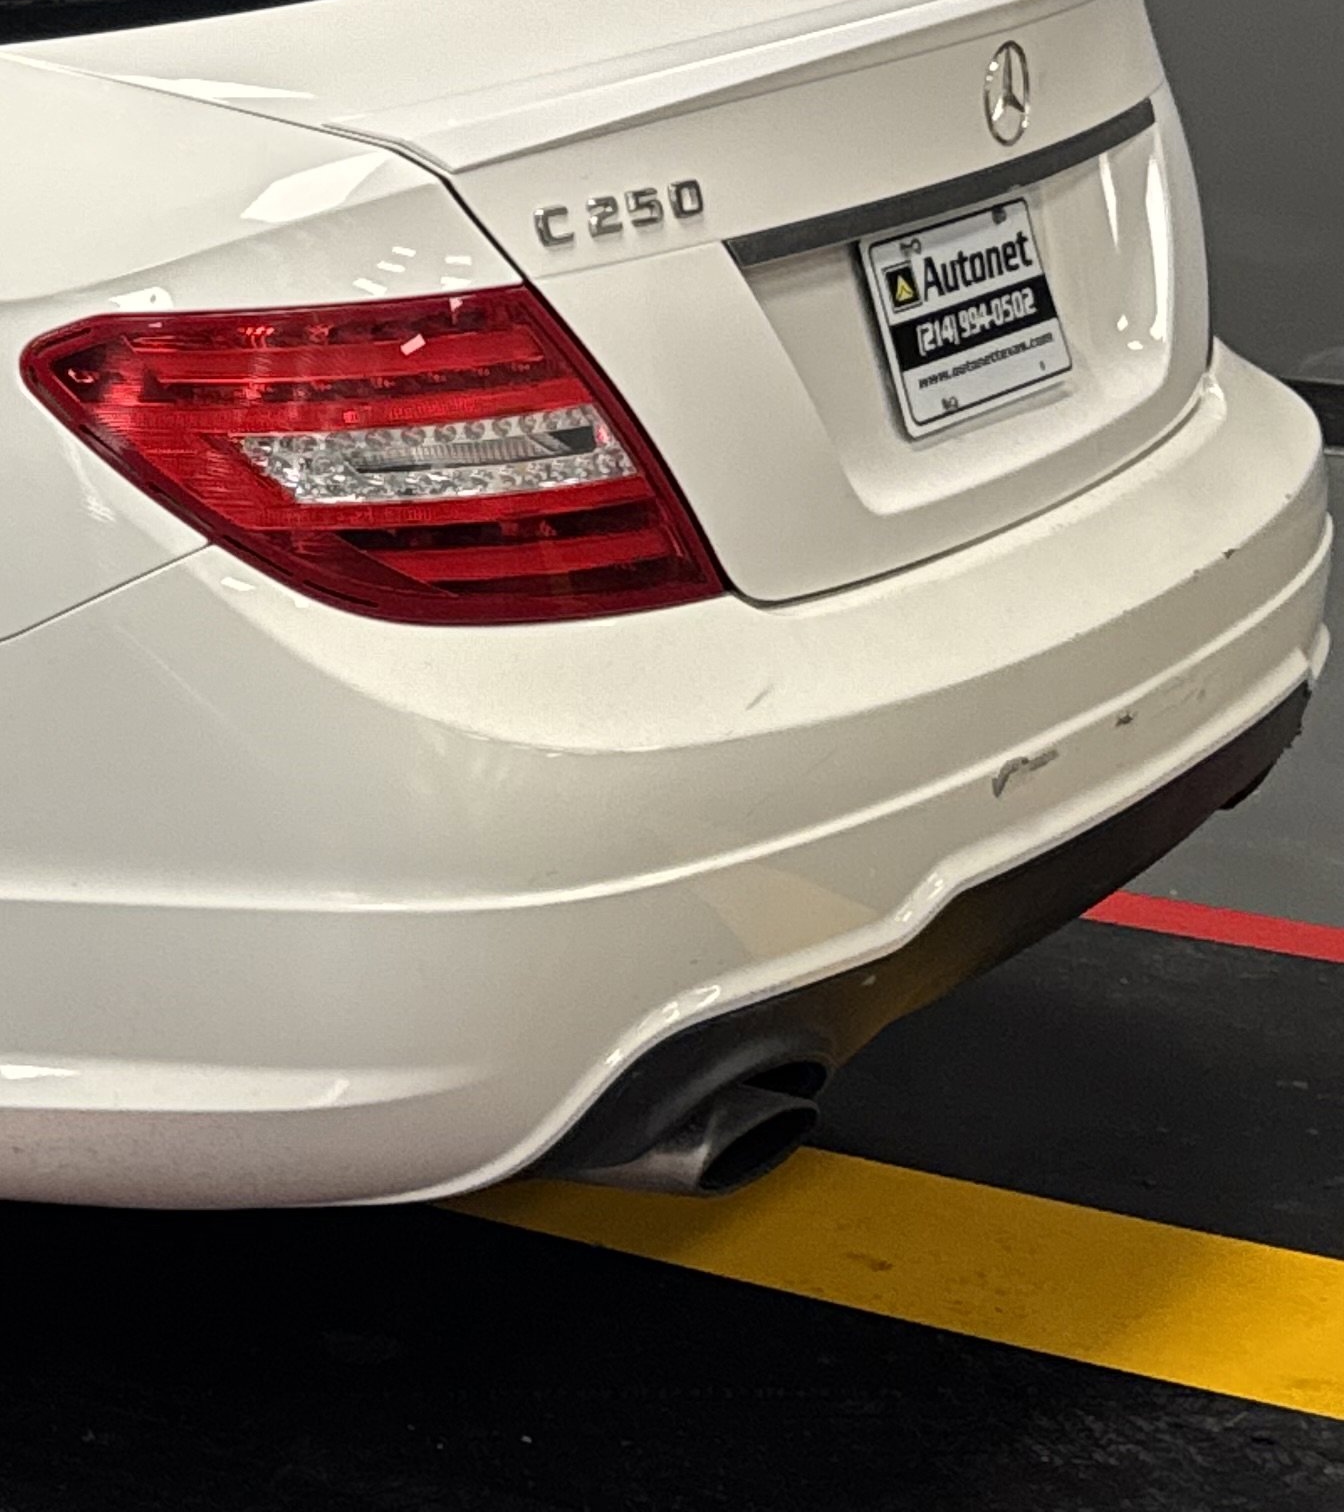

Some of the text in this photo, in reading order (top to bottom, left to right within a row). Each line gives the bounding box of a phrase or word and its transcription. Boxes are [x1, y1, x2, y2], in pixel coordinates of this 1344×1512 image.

[534, 180, 704, 247] C 250
[923, 231, 1033, 302] Autonet
[916, 318, 961, 357] (214)
